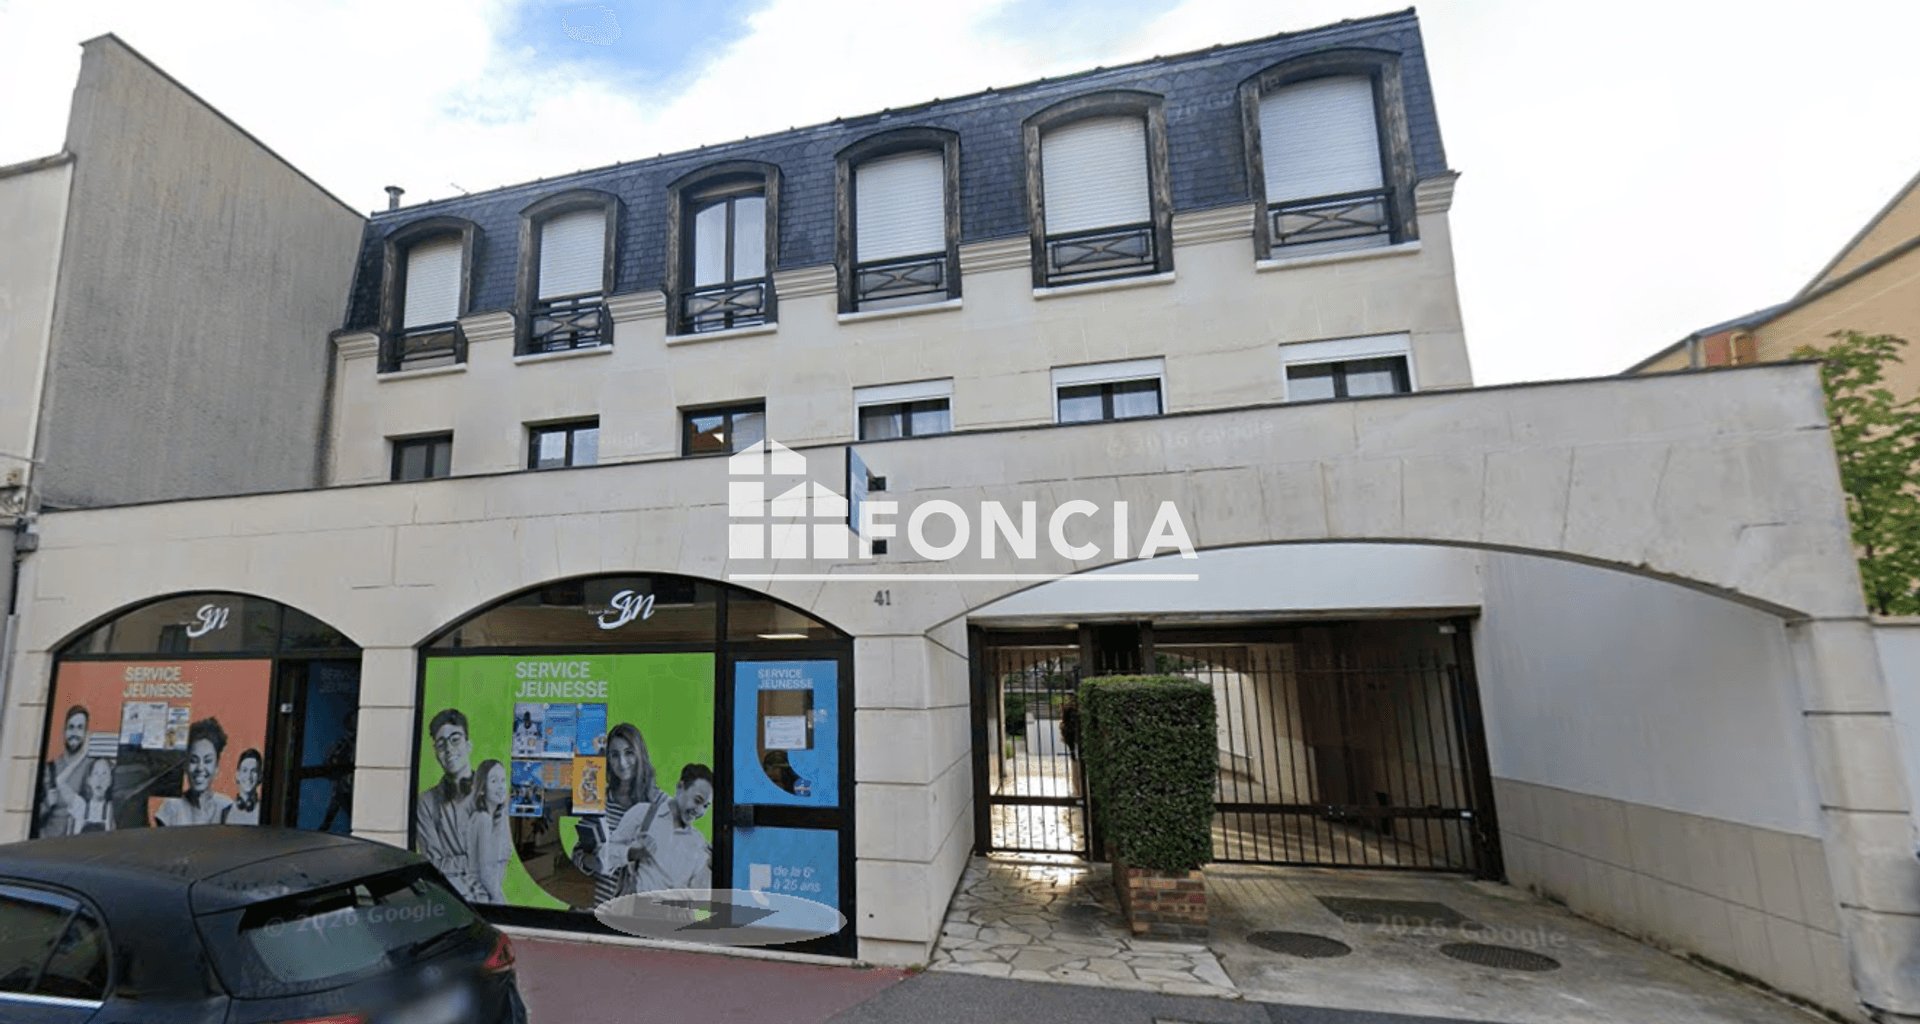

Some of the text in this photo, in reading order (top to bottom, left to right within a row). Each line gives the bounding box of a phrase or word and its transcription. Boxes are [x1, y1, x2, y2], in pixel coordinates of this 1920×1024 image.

[874, 590, 891, 605] 41
[125, 666, 182, 681] SERVICE
[515, 661, 591, 678] SERVICE
[758, 669, 802, 679] SERVICE
[123, 683, 193, 698] JEUNESSE
[514, 681, 608, 697] JEUNESSE
[758, 679, 814, 689] JEUNESSE
[773, 866, 788, 877] de
[800, 882, 821, 893] ans
